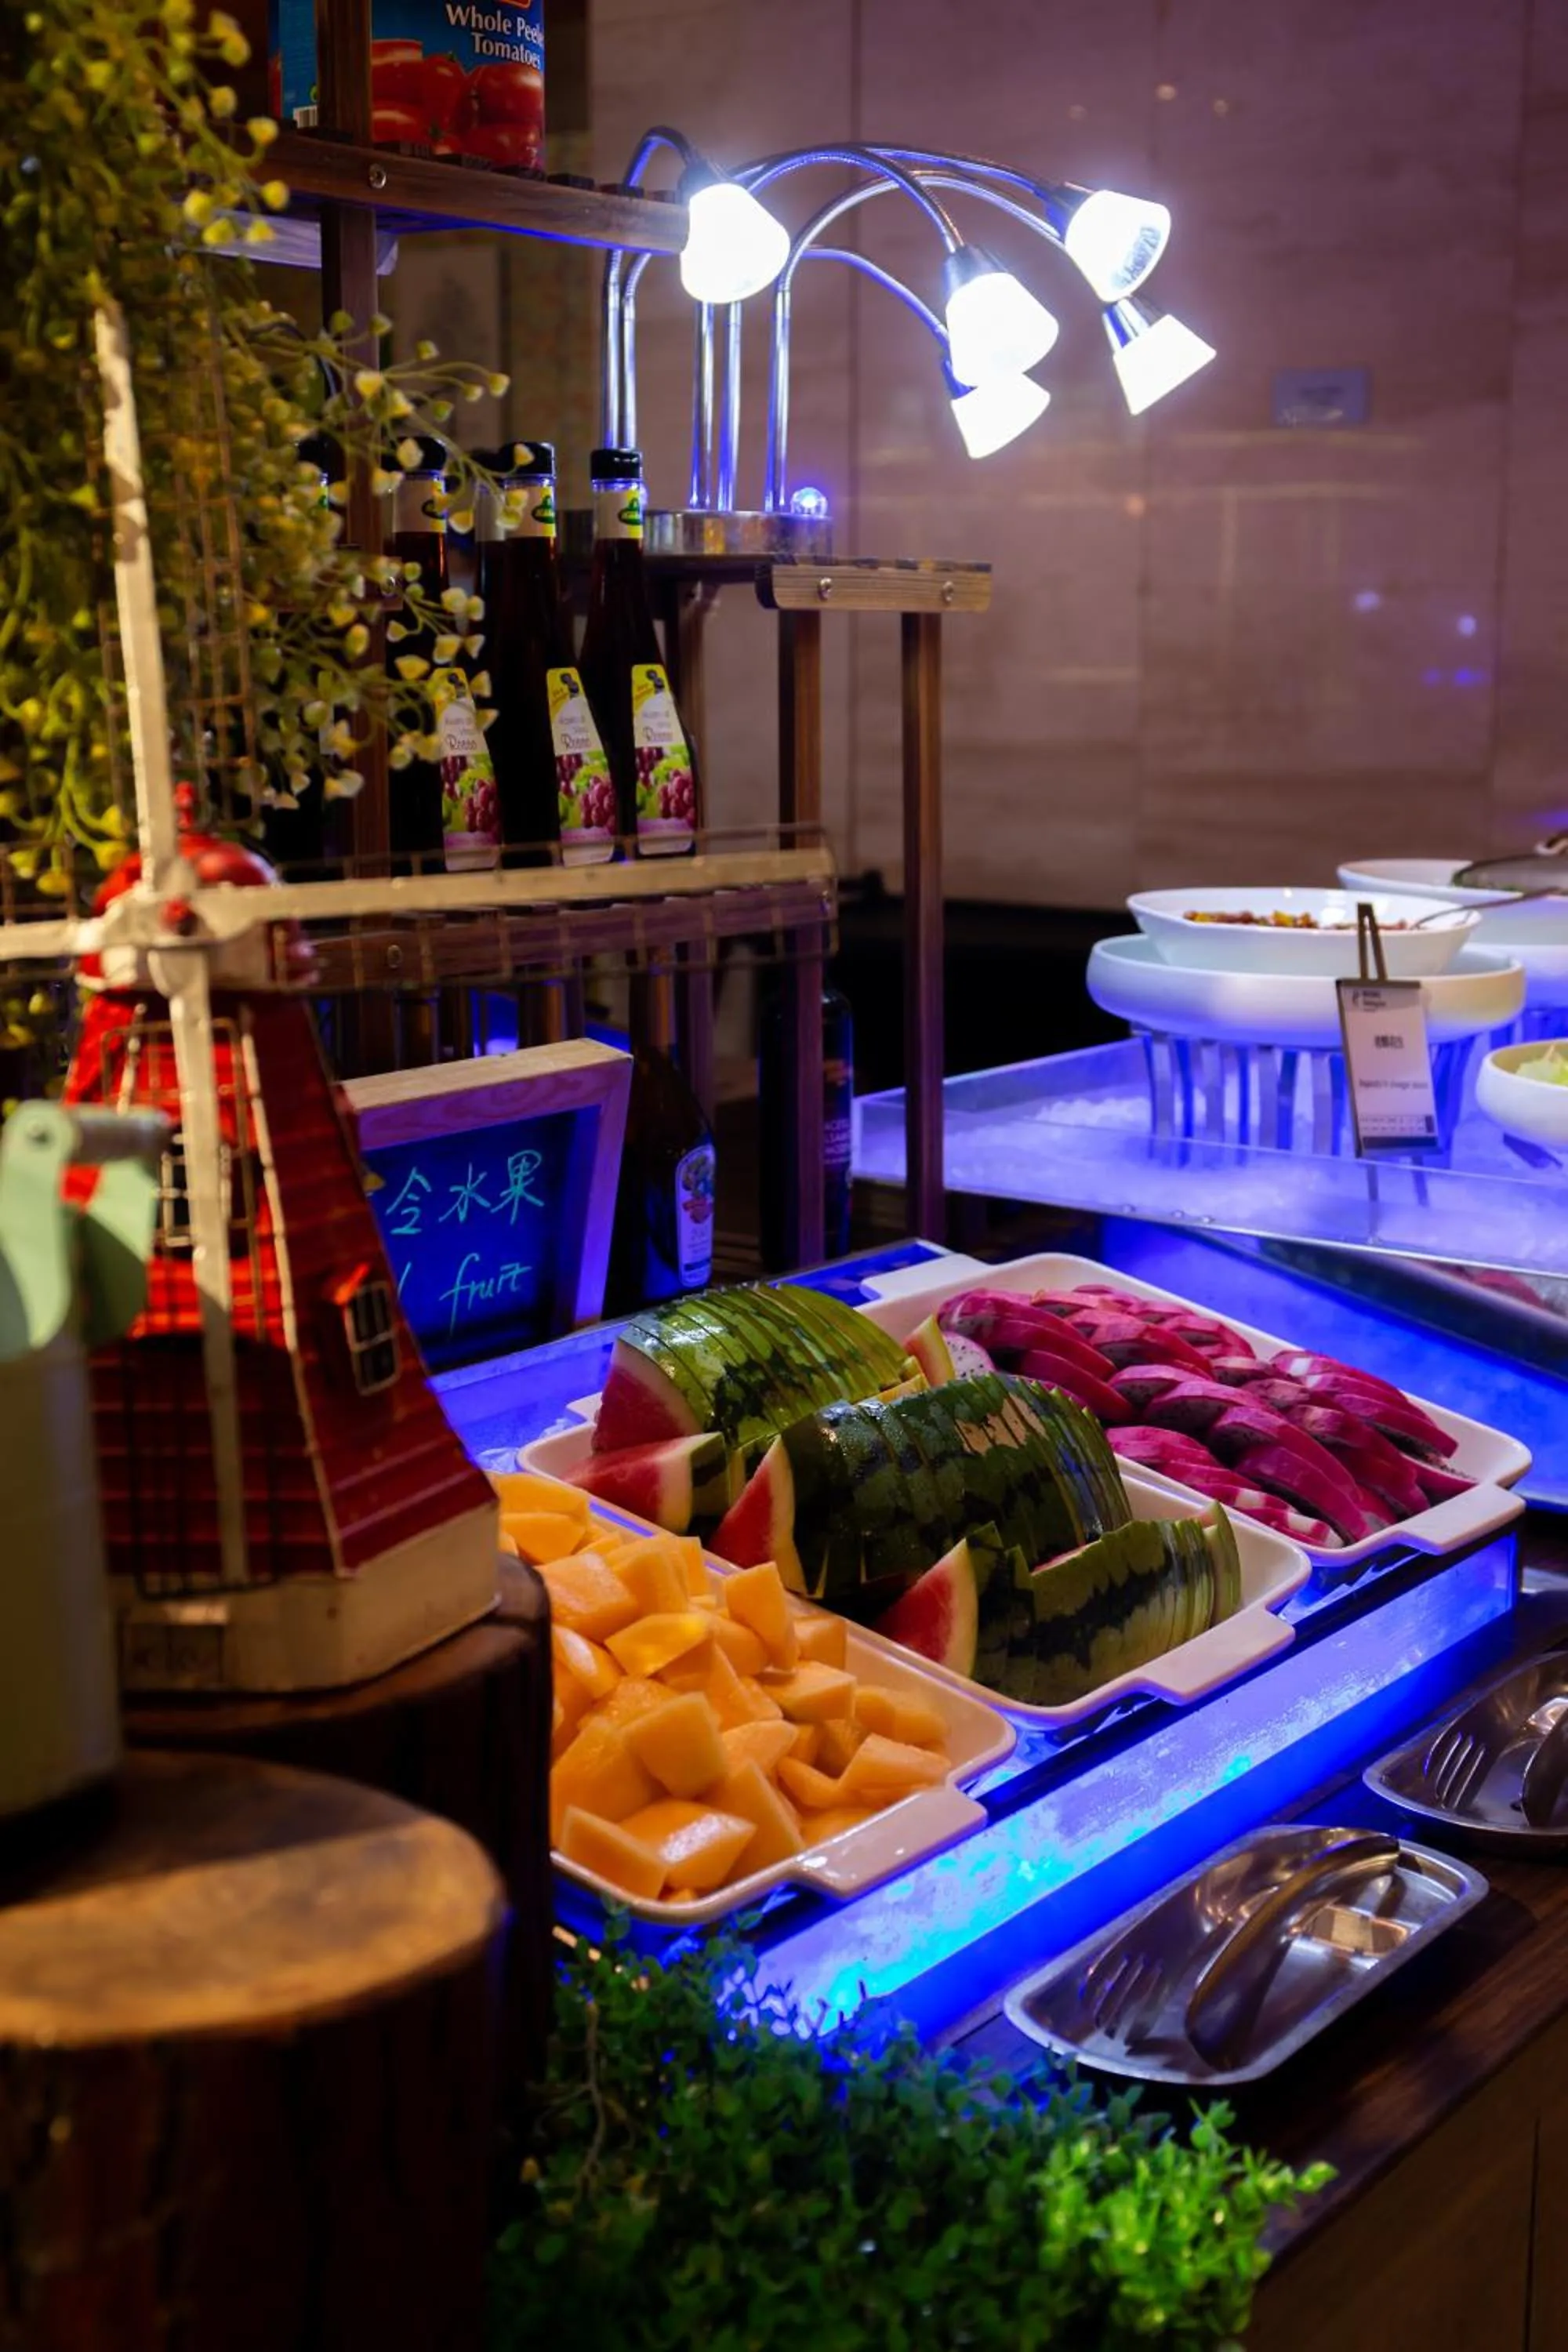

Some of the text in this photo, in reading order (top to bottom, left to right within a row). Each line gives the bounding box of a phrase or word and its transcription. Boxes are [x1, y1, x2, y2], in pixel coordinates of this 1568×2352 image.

[446, 3, 512, 35] Whole
[471, 32, 540, 70] Tomatoes
[439, 1252, 532, 1336] fruit
